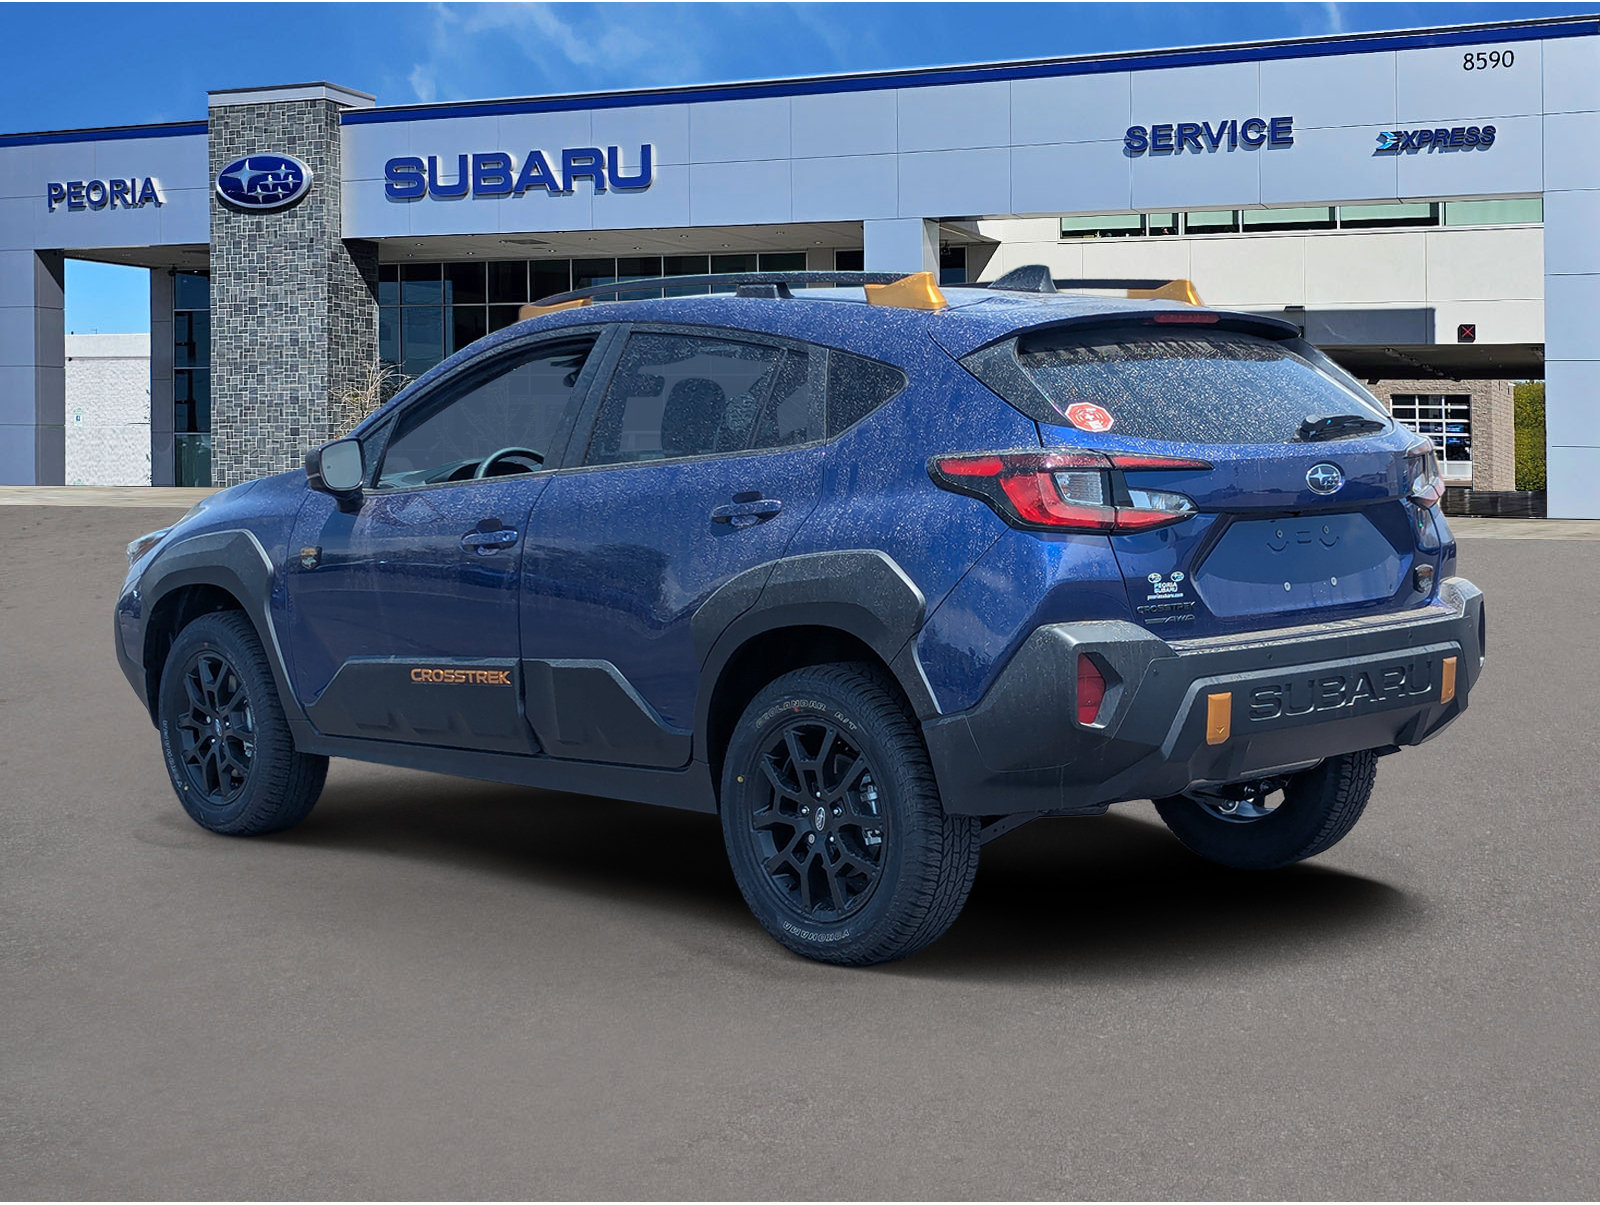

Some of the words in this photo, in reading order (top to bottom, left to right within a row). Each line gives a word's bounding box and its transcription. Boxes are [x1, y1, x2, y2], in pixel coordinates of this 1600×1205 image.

[1462, 50, 1515, 71] 8590
[1124, 116, 1294, 153] SERVICE
[1375, 125, 1497, 152] EXPRESS
[384, 144, 653, 201] SUBARU
[47, 177, 162, 210] PEORIA
[1136, 601, 1196, 614] CROSSTREK
[410, 668, 511, 685] CROSSTREK
[1250, 660, 1433, 722] SUBARU
[756, 699, 827, 728] GEOLANDAR
[783, 921, 850, 942] YOKOHAMA
